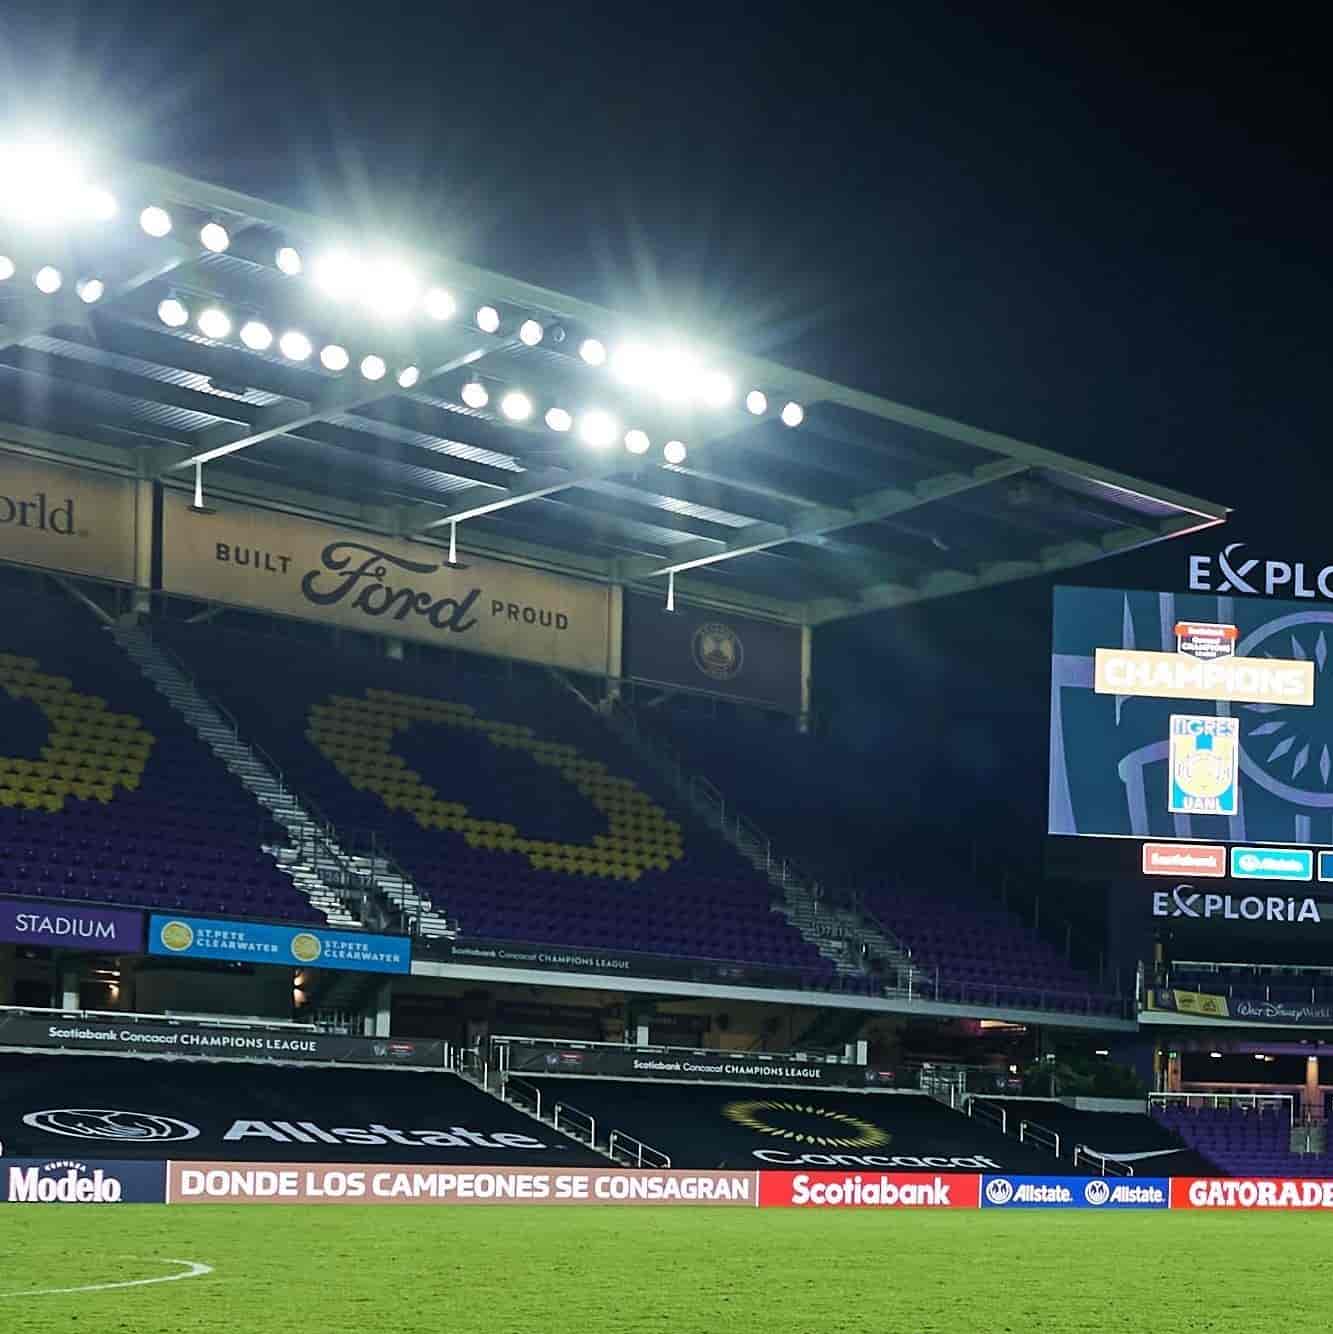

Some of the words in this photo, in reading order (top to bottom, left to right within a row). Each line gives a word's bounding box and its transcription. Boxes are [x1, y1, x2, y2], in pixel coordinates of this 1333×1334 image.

[216, 543, 292, 574] BUILT
[301, 541, 482, 633] Ford
[491, 599, 569, 630] PROUD
[1104, 656, 1305, 695] CHAMPIONS
[1153, 885, 1320, 923] EXPLORIA
[15, 914, 116, 939] STADIUM
[196, 939, 278, 952] CLEARWATER
[323, 950, 400, 963] CLEARWATER
[537, 952, 594, 967] CHAMPIONS
[596, 958, 630, 970] LEAGUE
[49, 1026, 117, 1041] Scotiabank
[120, 1031, 178, 1044] Concacaf
[180, 1034, 263, 1049] CHAMPIONS
[266, 1038, 317, 1051] LEAGUE
[633, 1059, 681, 1072] Scotiabank
[683, 1062, 723, 1074] Concacaf
[725, 1064, 783, 1077] CHAMPIONS
[785, 1066, 821, 1079] LEAGUE
[223, 1119, 547, 1149] Allstate
[751, 1149, 1003, 1169] Concacaf
[8, 1166, 122, 1203] Modelo
[181, 1169, 299, 1197] DONDE
[307, 1172, 366, 1197] LOS
[373, 1174, 549, 1199] CAMPEONES
[555, 1176, 590, 1199] SE
[595, 1176, 749, 1201] CONSAGRAN
[792, 1175, 951, 1205] Scotiabank
[1013, 1184, 1069, 1202] Allstate
[1110, 1185, 1162, 1203] Allstate
